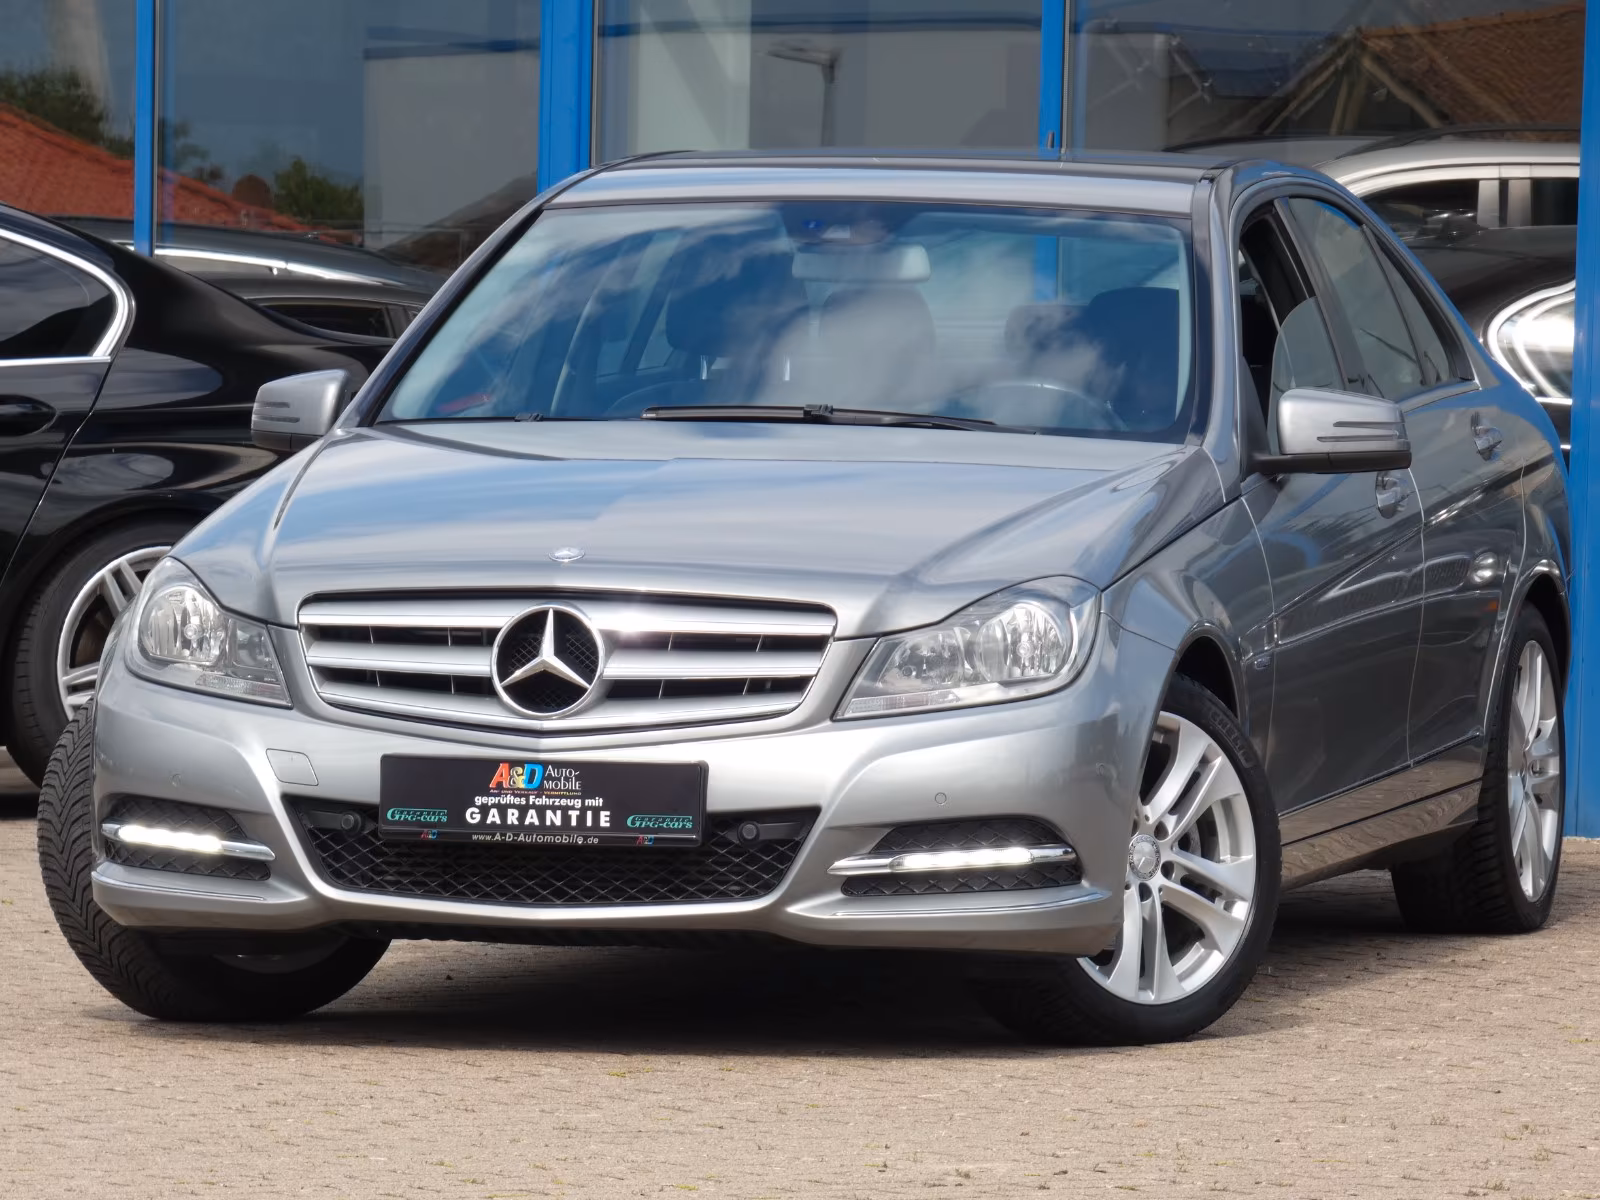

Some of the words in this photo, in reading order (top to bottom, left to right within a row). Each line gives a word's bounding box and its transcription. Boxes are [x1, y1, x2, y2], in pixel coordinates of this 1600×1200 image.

[489, 762, 544, 789] A&D
[474, 794, 526, 806] geprüftes
[529, 795, 582, 808] Fahrzeug
[585, 797, 604, 807] mit
[465, 807, 611, 827] GARANTIE
[472, 832, 599, 844] www.A-D-Automobile.de
